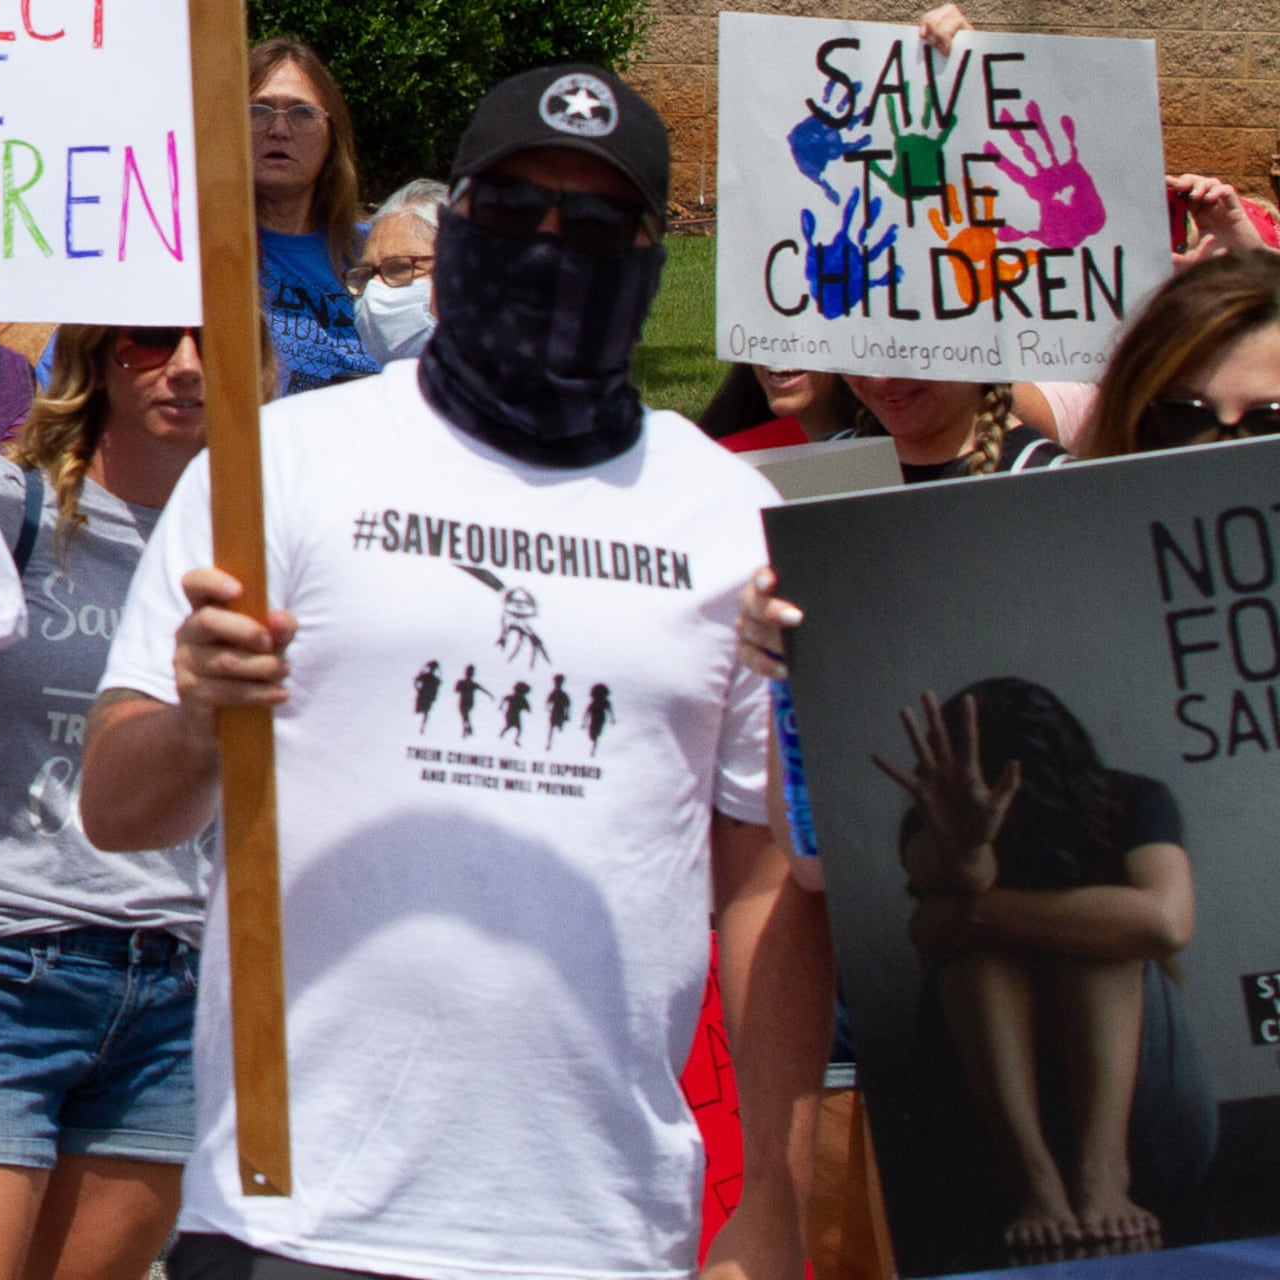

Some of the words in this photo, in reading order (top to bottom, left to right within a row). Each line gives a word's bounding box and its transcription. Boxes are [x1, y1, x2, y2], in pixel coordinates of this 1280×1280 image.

[806, 38, 1040, 131] SAVE
[844, 150, 1005, 228] THE
[765, 239, 1123, 322] CHILDREN
[729, 324, 831, 358] Operation
[851, 334, 1002, 369] Underground
[1017, 330, 1114, 366] Railroa
[352, 509, 692, 591] #SAVEOURCHILDREN
[1151, 504, 1280, 603] NO
